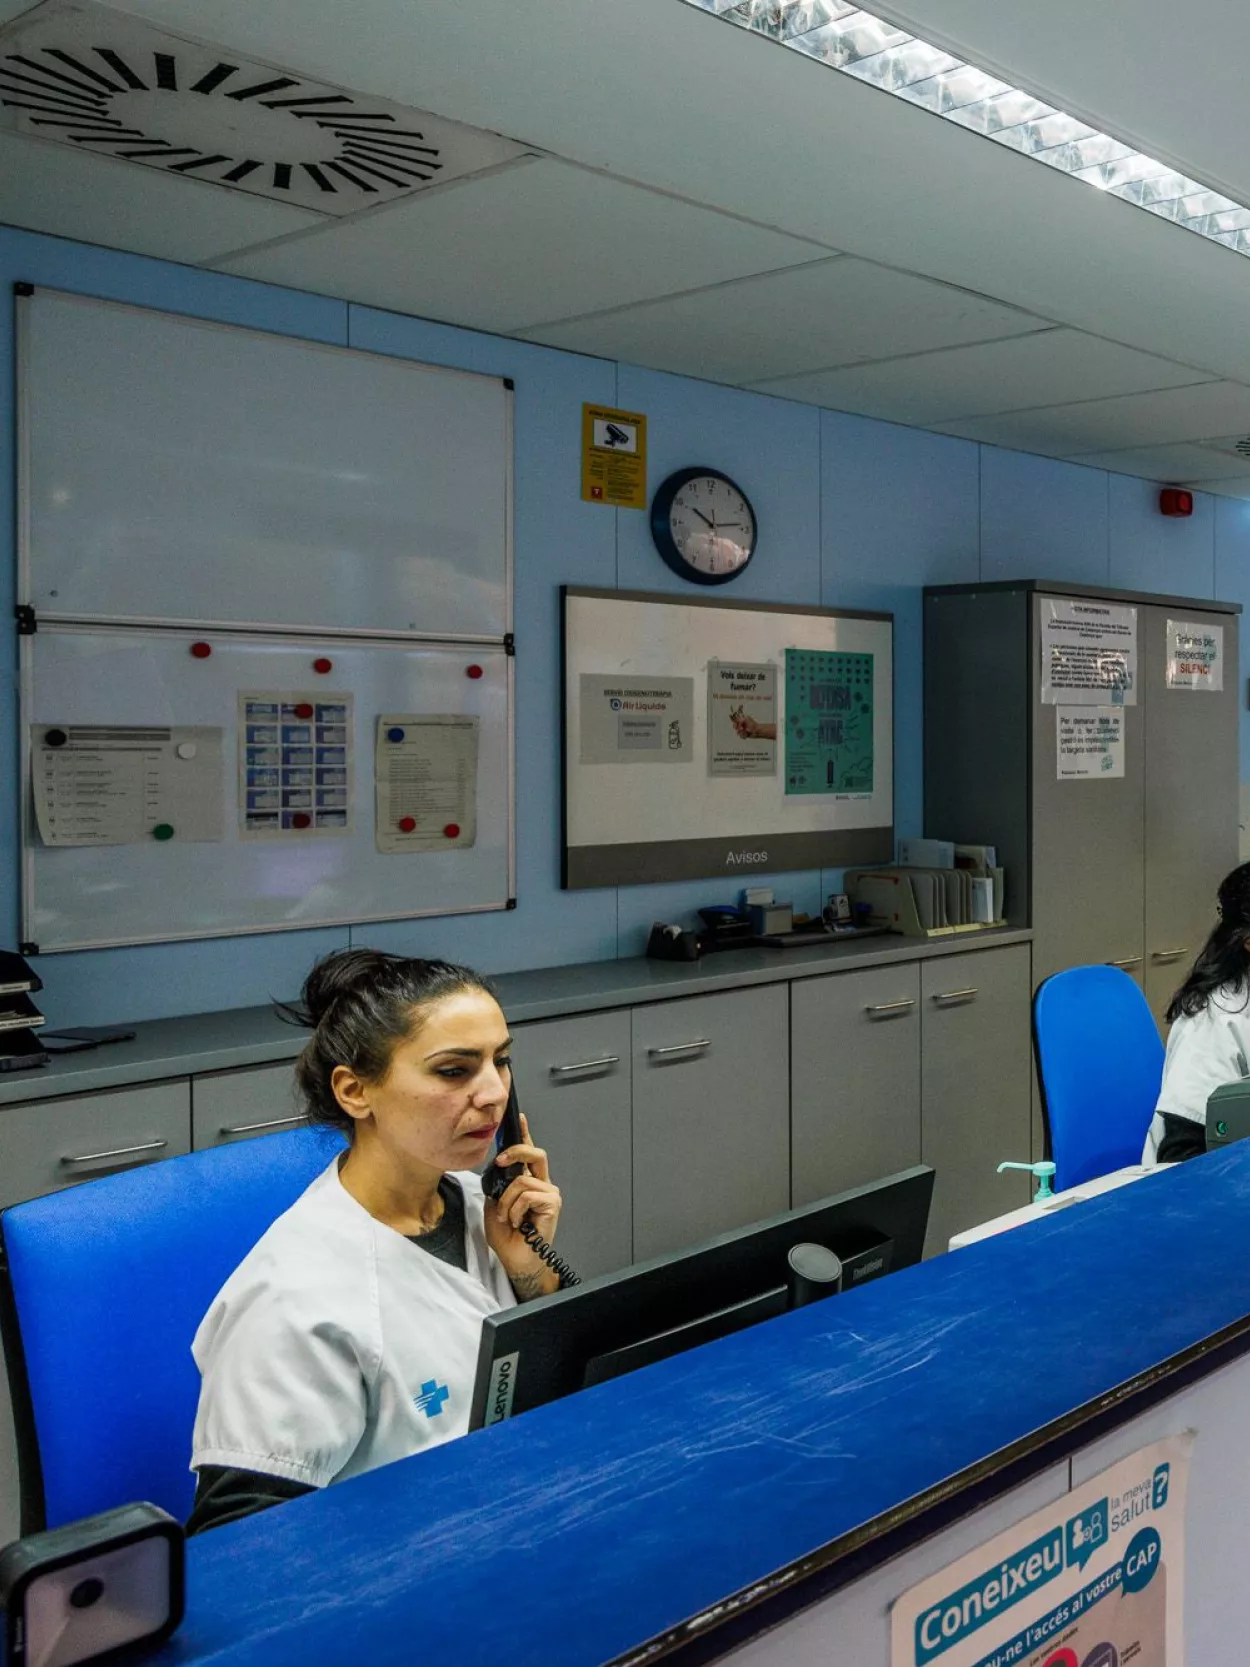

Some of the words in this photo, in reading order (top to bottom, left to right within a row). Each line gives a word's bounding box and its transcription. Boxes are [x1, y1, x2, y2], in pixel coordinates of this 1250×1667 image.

[706, 480, 716, 489] 12
[736, 671, 756, 681] deixar
[757, 673, 766, 681] de
[730, 682, 756, 692] fumar?
[622, 702, 635, 711] Air
[635, 701, 666, 713] Liquide
[1060, 717, 1070, 725] Per
[726, 850, 769, 865] Avisos
[1110, 1497, 1120, 1510] la
[1121, 1480, 1151, 1504] meva
[1110, 1492, 1151, 1533] salut
[919, 1536, 1061, 1651] Coneixeu
[1025, 1608, 1070, 1647] l'accés
[1071, 1594, 1084, 1616] al
[1085, 1567, 1122, 1603] vostre
[1126, 1541, 1158, 1577] CAP
